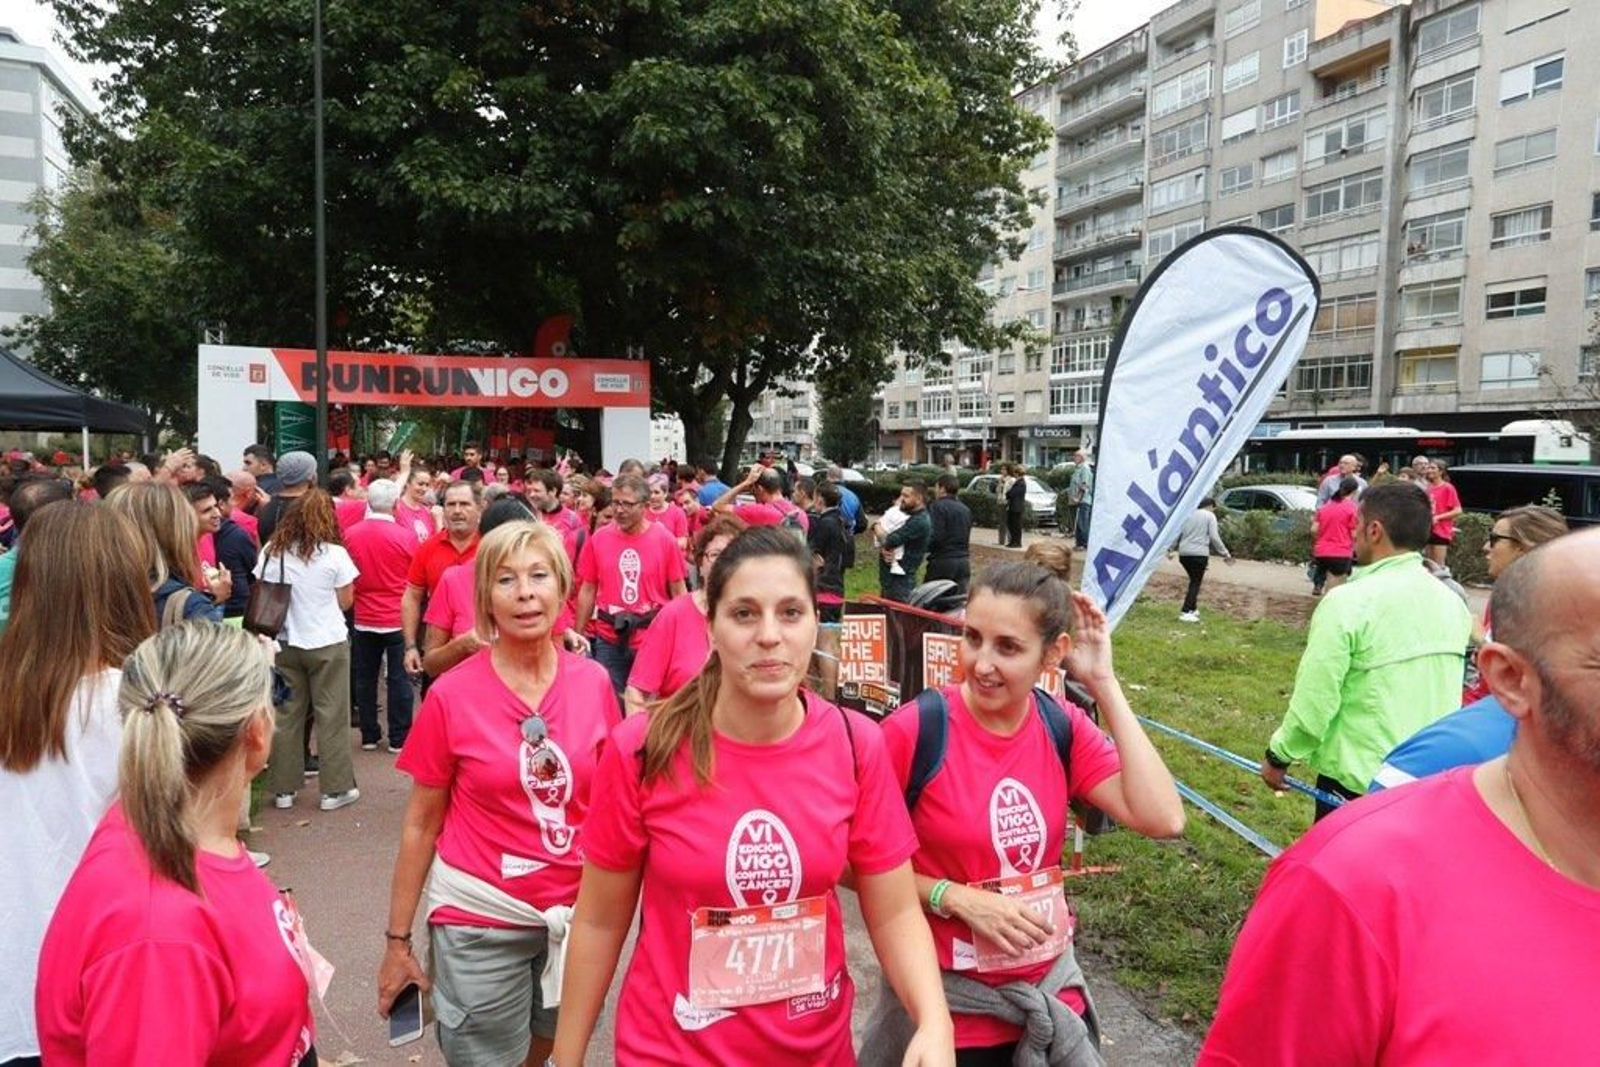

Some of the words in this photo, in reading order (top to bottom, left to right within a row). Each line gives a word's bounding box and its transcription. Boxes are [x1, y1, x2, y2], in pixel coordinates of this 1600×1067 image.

[1092, 286, 1293, 603] Atlántico
[841, 621, 881, 640] SAVE
[840, 641, 873, 660] THE
[927, 641, 959, 665] SAVE
[999, 789, 1020, 805] VI
[1000, 812, 1034, 830] VIGO
[746, 823, 772, 842] VI
[737, 853, 789, 870] VIGO
[736, 869, 777, 880] CONTRA
[779, 869, 793, 878] EL
[725, 932, 794, 975] 4771
